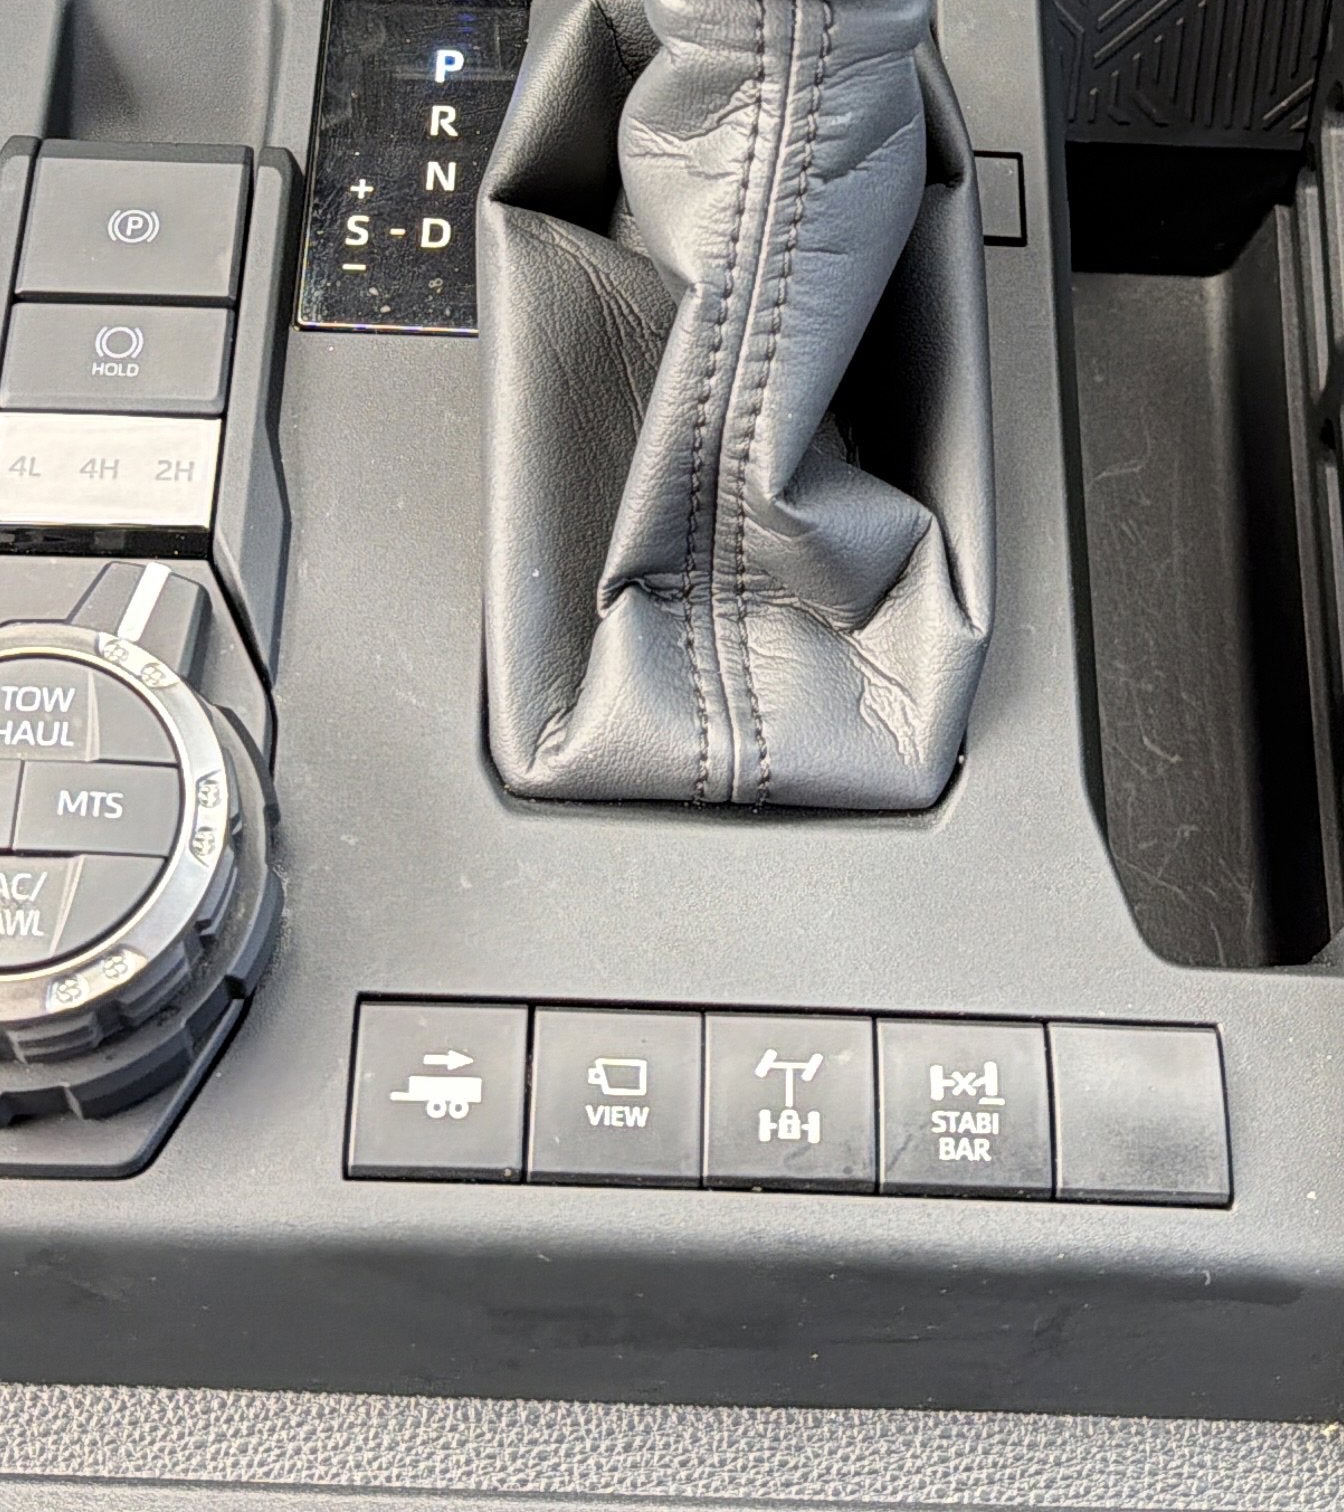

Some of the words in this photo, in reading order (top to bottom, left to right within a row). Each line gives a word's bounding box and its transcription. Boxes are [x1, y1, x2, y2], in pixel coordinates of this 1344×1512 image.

[435, 49, 465, 83] P
[430, 106, 459, 137] R
[426, 161, 457, 192] N
[346, 215, 369, 247] S
[420, 218, 452, 249] D
[91, 362, 140, 378] HOLD
[9, 456, 41, 477] 4L
[80, 458, 120, 480] 4H
[155, 460, 195, 482] 2H
[1, 685, 75, 713] TOW
[56, 790, 124, 819] MTS
[586, 1105, 650, 1128] VIEW
[931, 1110, 1000, 1135] STABI
[938, 1137, 992, 1163] BAR
